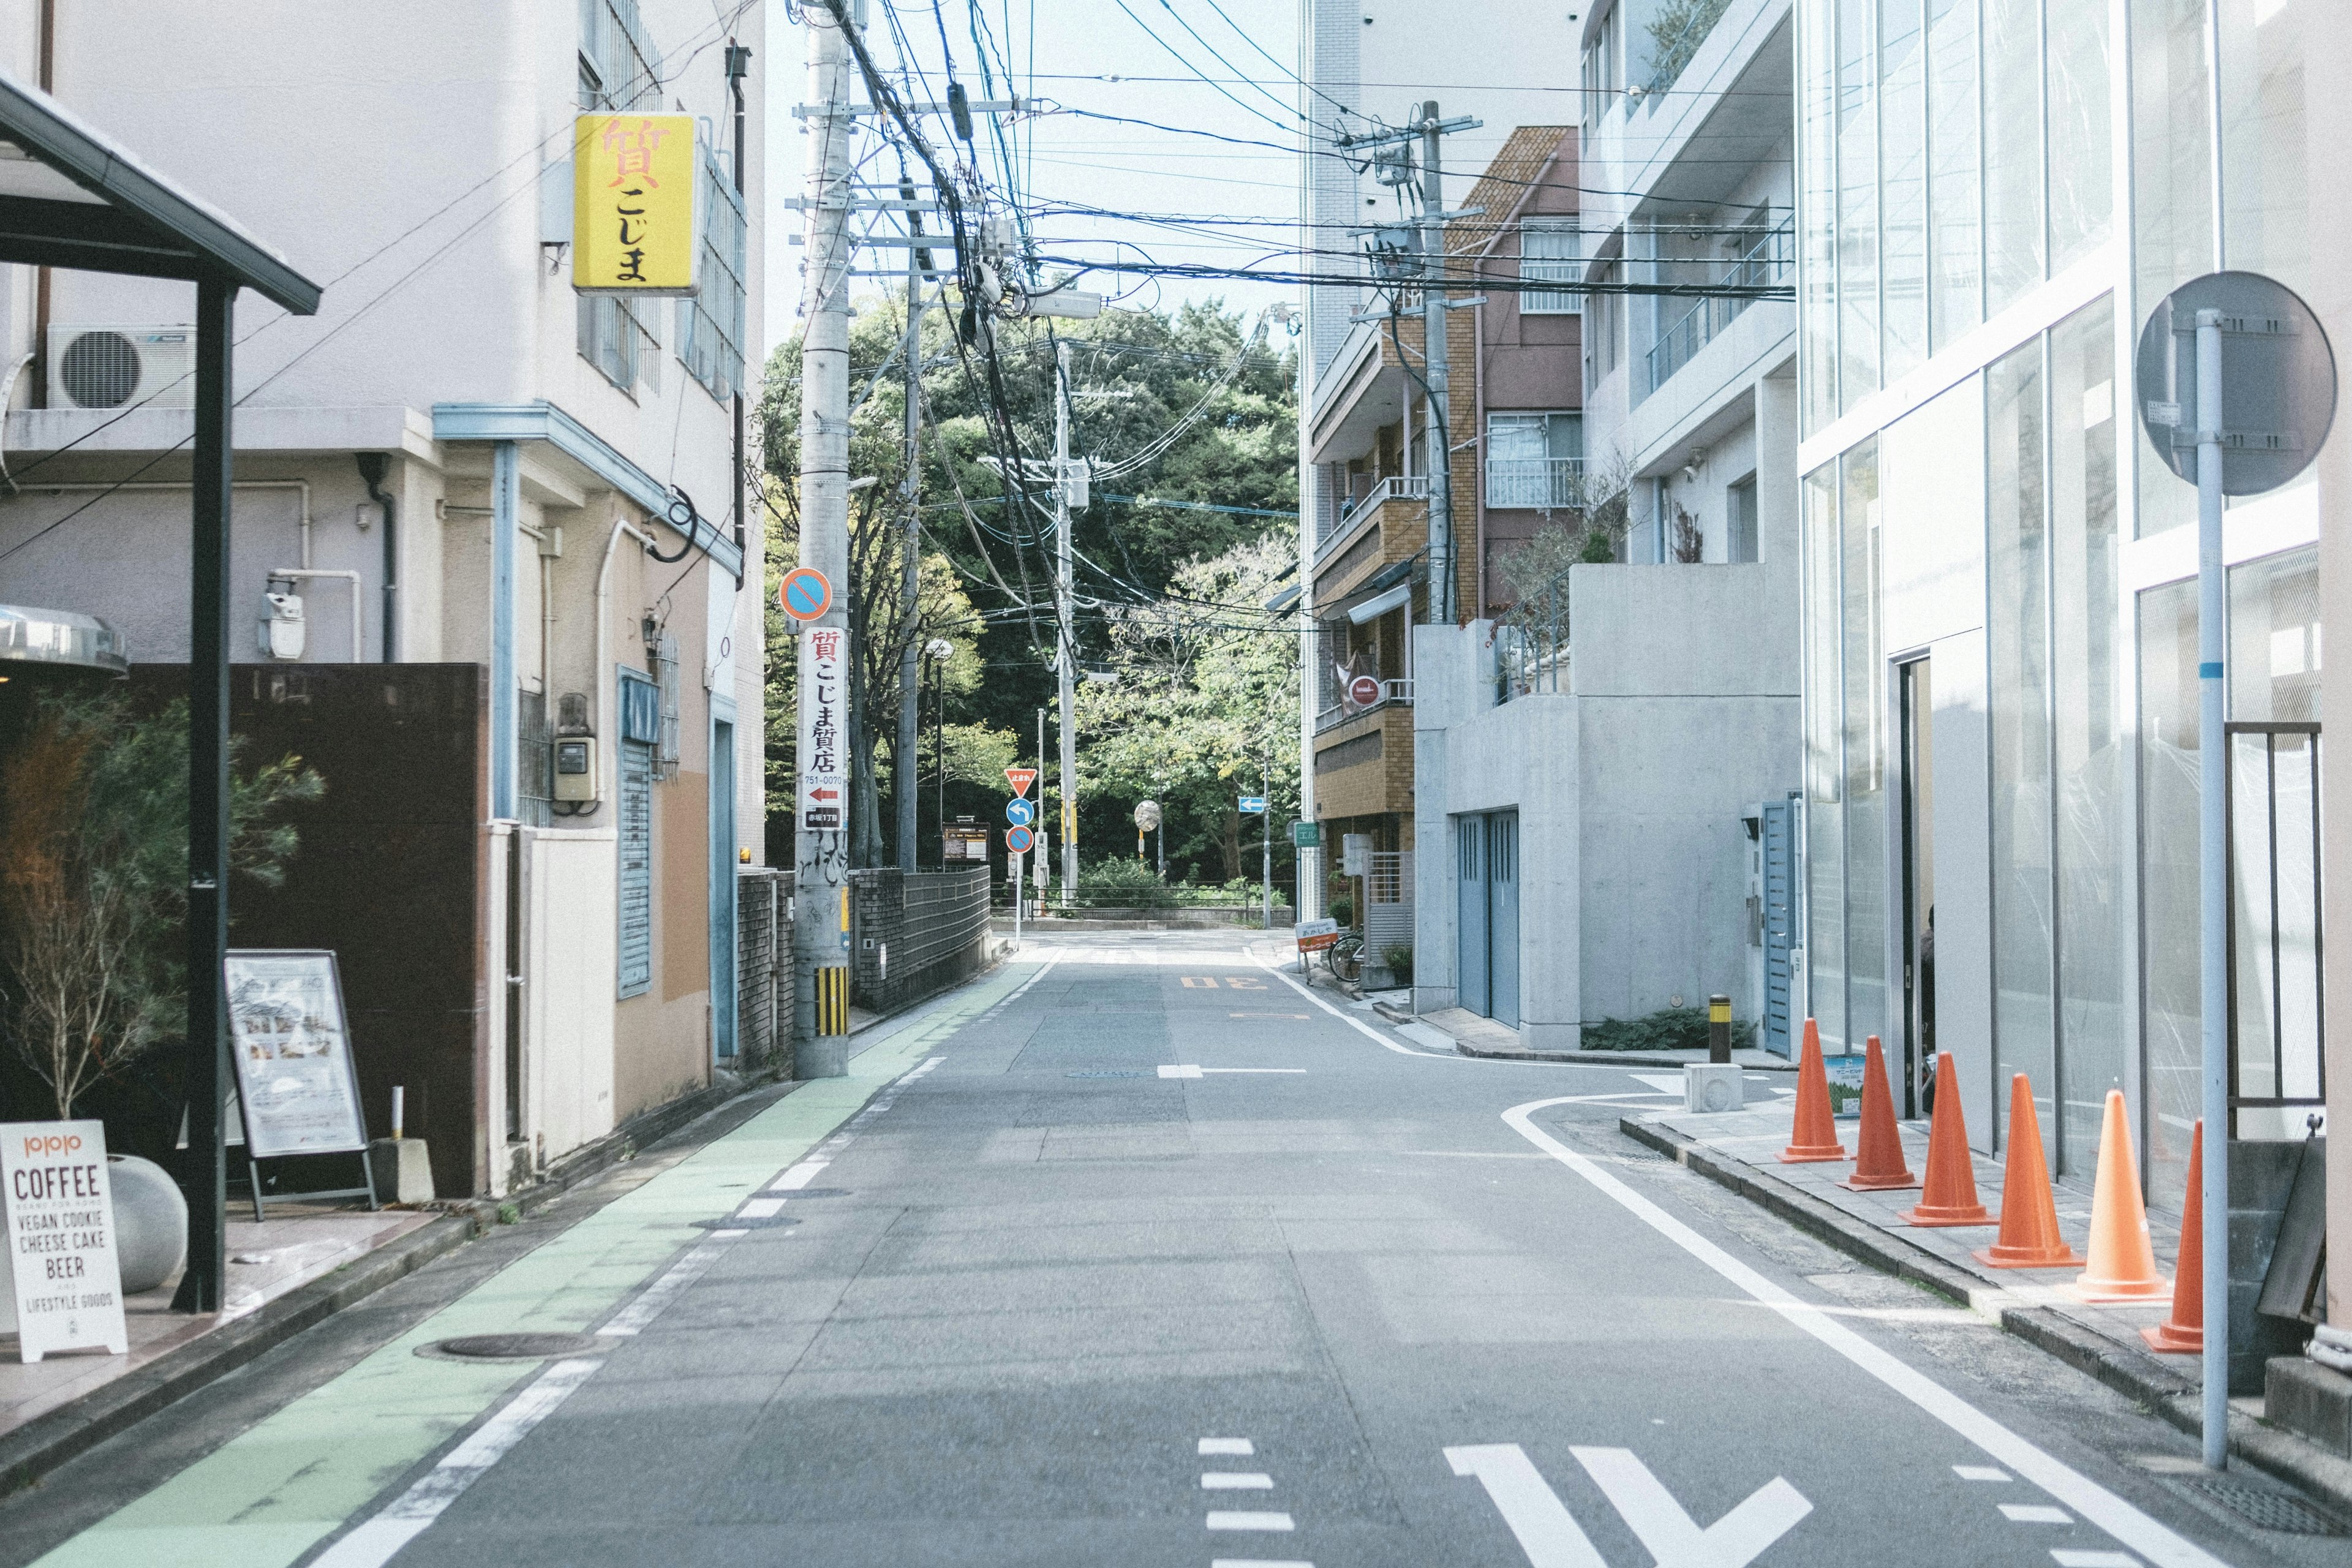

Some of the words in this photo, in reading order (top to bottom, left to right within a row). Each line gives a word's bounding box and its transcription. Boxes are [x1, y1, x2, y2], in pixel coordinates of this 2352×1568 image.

[601, 119, 671, 189] 質
[616, 189, 647, 282] こじま
[805, 776, 842, 785] 751-0070
[1299, 831, 1316, 839] エル
[14, 1165, 100, 1200] COFFEE
[18, 1213, 57, 1231] VEGAN
[62, 1210, 103, 1228] COOKIE
[20, 1234, 67, 1254] CHEESE
[72, 1231, 105, 1250] CAKE
[46, 1256, 85, 1280] BEER
[26, 1295, 77, 1313] LIFESTYLE
[81, 1292, 113, 1308] GOODS
